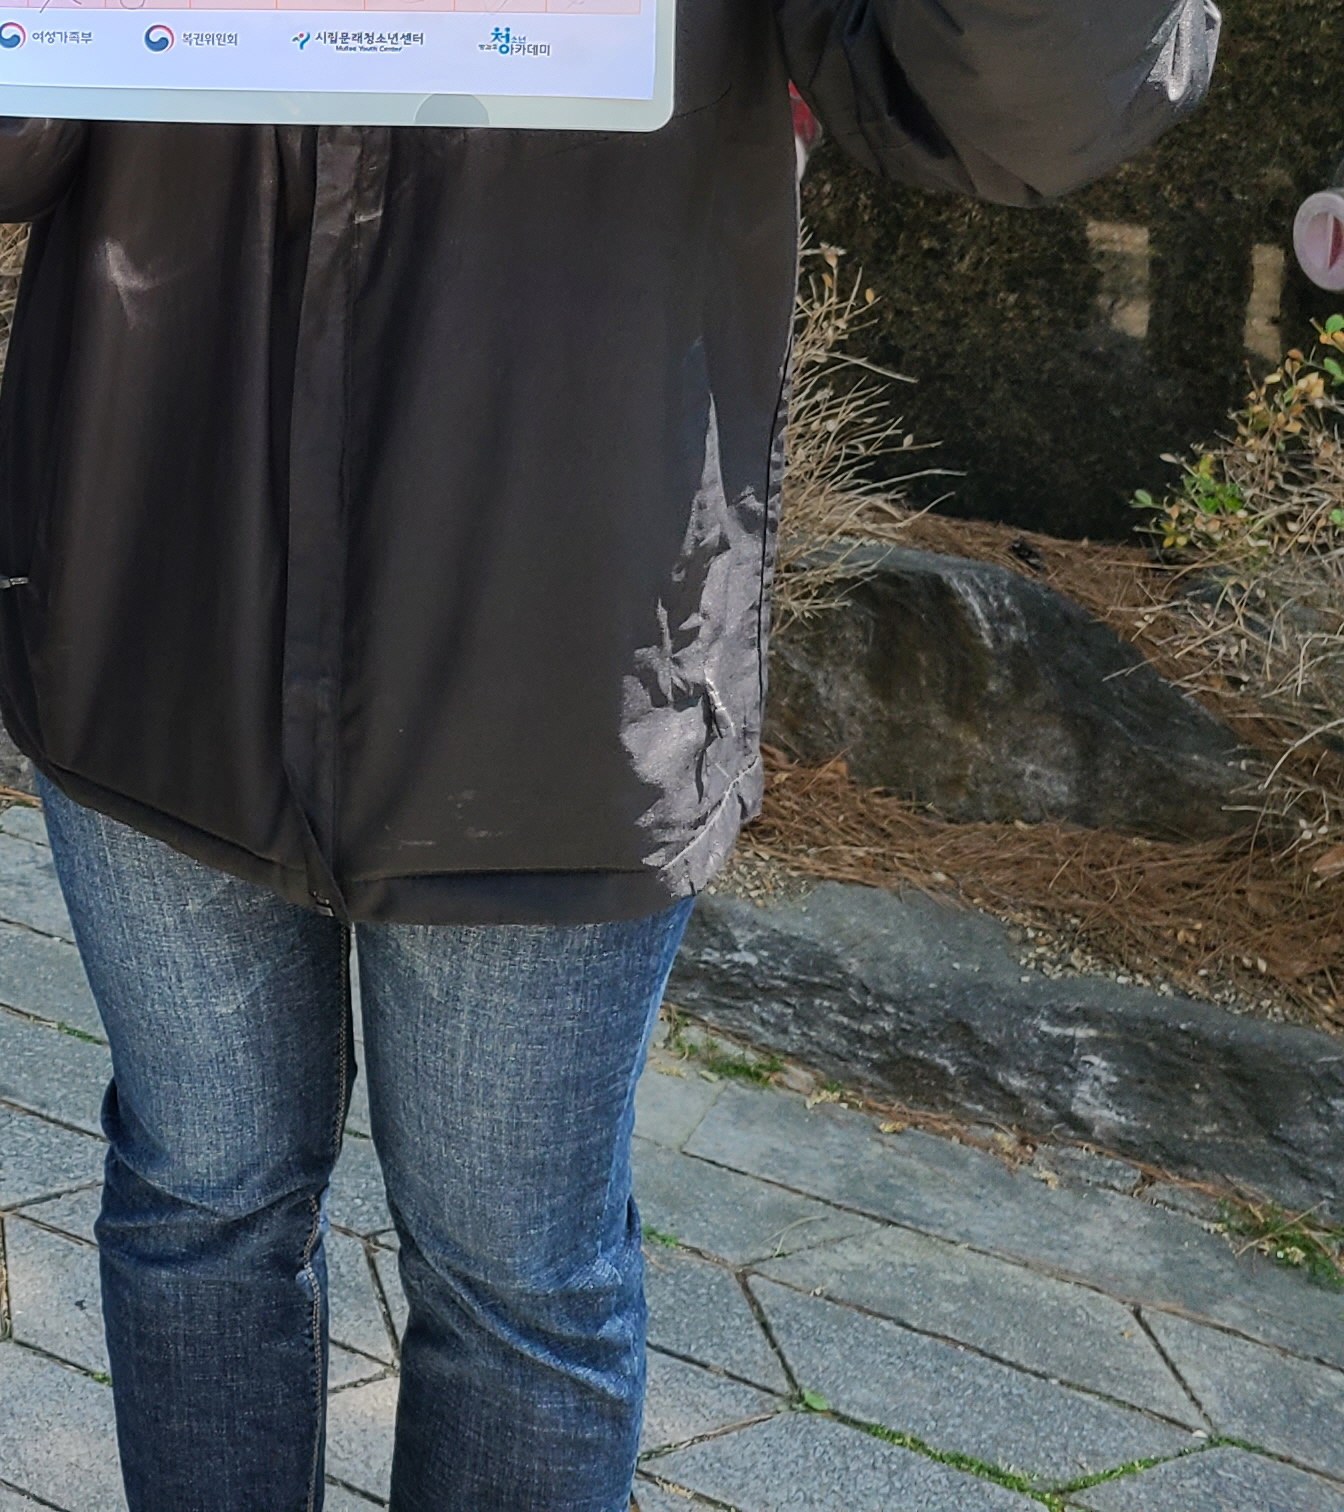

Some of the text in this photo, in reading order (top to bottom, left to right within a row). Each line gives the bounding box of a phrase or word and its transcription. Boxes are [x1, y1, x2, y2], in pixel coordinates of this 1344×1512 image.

[31, 30, 94, 46] 여성가족부
[182, 31, 239, 48] 복권위원회
[315, 31, 425, 46] 시립문래청소년센터
[499, 43, 551, 57] 아카데미
